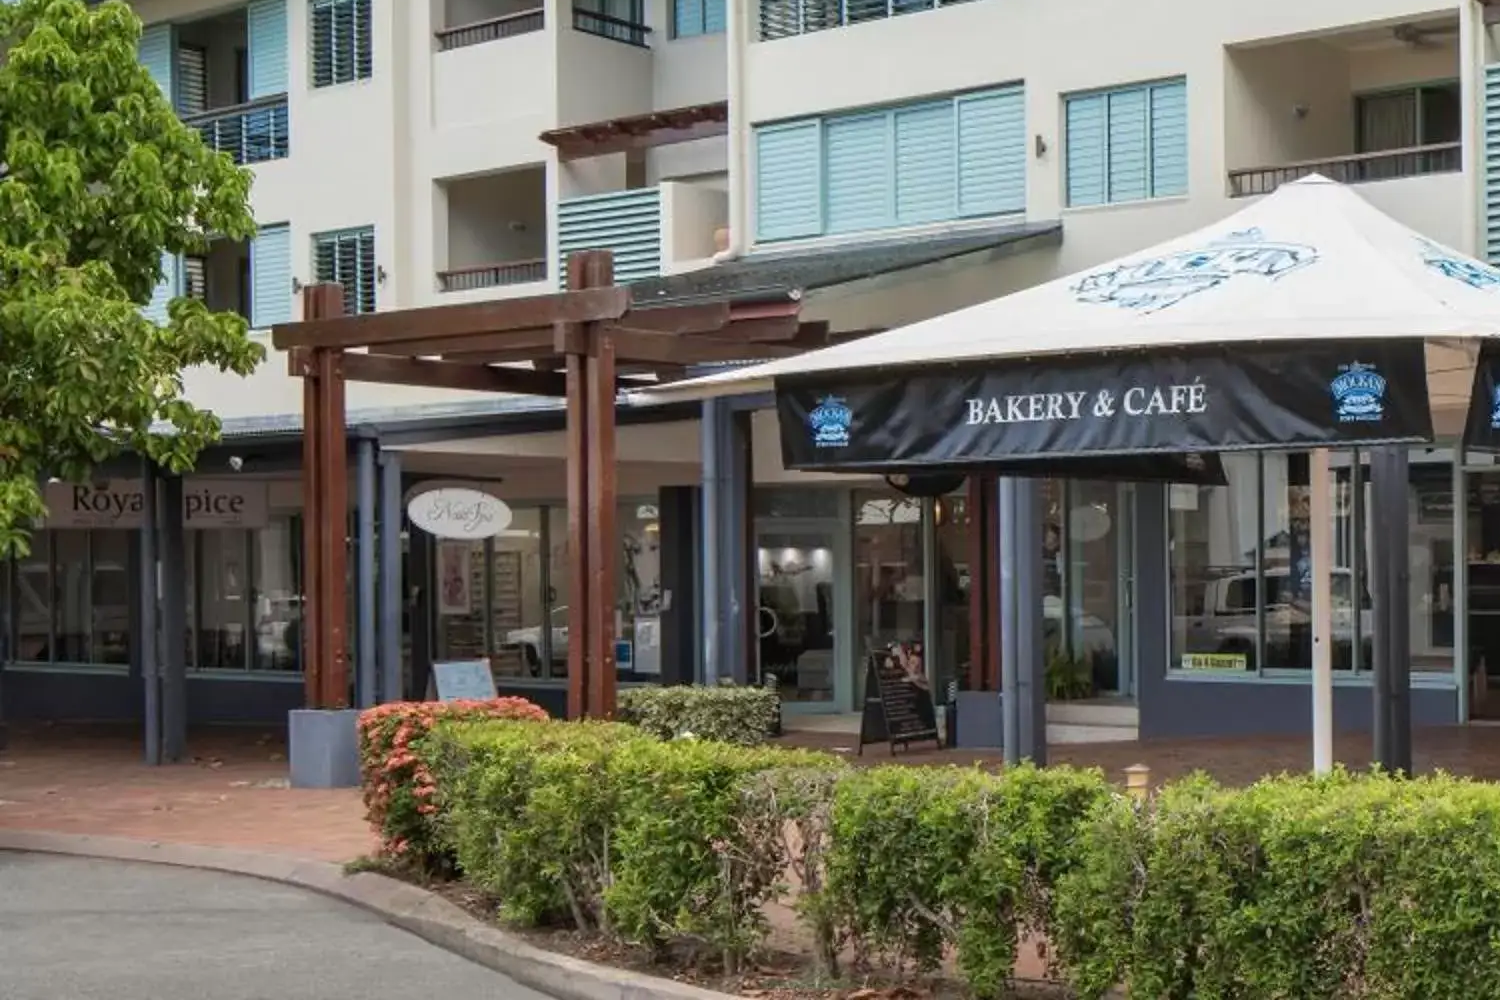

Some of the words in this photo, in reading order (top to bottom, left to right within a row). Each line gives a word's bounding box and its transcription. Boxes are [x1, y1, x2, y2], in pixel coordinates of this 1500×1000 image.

[966, 391, 1087, 425] BAKERY
[1093, 389, 1115, 417] &
[1123, 376, 1207, 416] CAFÉ
[72, 484, 143, 518] Roya
[185, 488, 245, 520] pice
